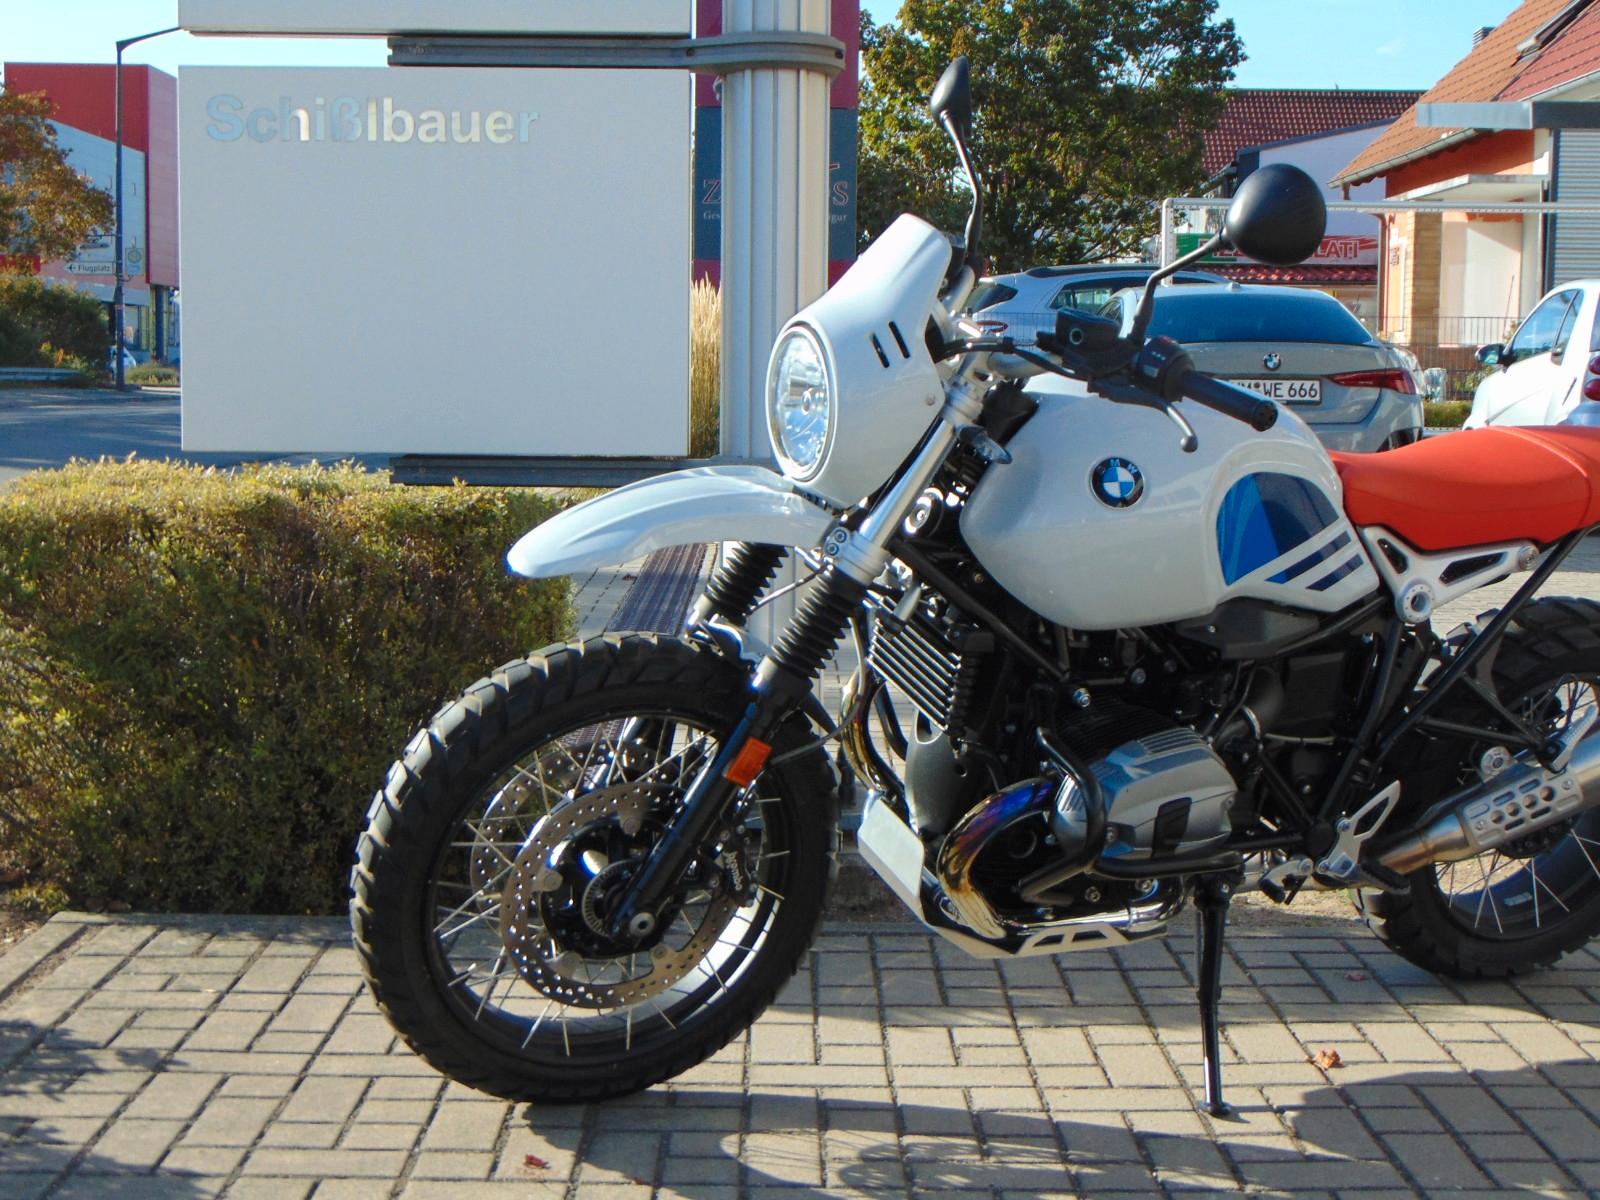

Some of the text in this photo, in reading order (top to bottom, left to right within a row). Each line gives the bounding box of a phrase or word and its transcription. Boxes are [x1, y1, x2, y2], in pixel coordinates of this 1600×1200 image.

[206, 94, 539, 143] Schißlbauer
[1313, 240, 1358, 258] LATI
[1263, 383, 1284, 398] WE
[1288, 383, 1318, 398] 666
